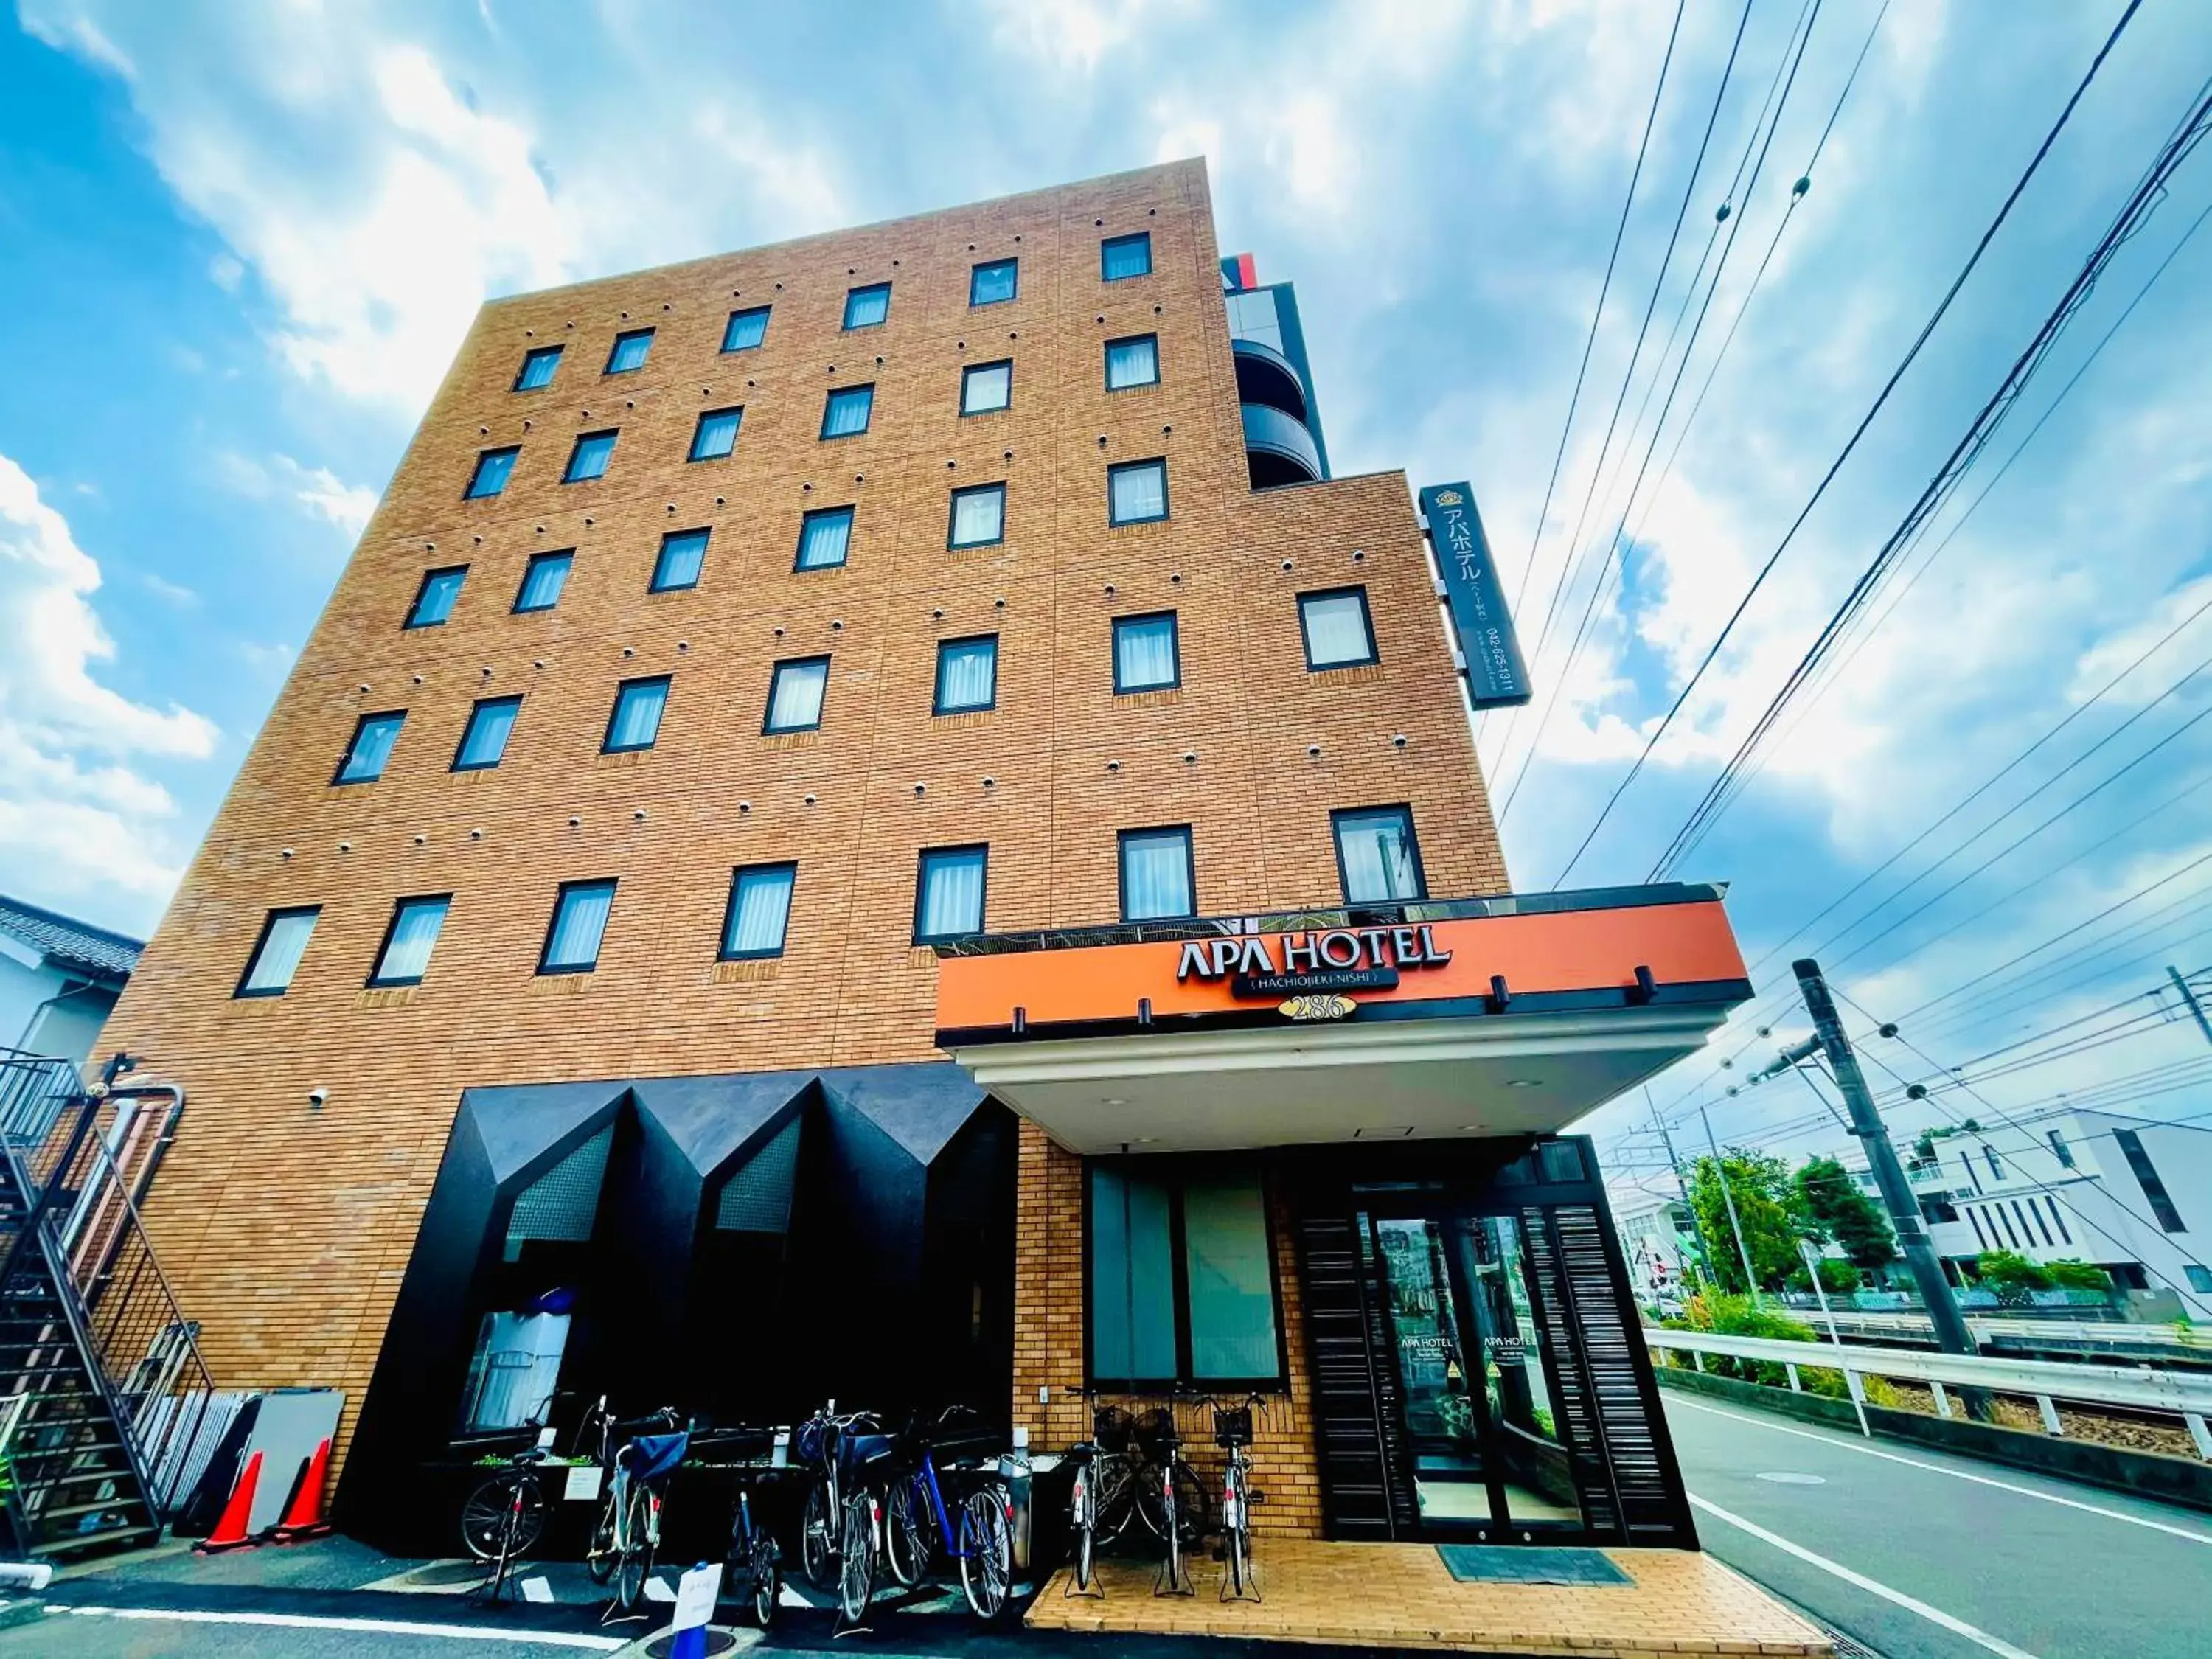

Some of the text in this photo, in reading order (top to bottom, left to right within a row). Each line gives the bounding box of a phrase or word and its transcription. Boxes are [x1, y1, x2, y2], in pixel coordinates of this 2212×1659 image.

[1443, 509, 1481, 581] アパホテル
[1177, 925, 1453, 978] APA HOTEL
[1291, 994, 1345, 1020] 286
[1402, 1338, 1453, 1348] APA HOTEL
[1484, 1336, 1537, 1346] APA HOTEL
